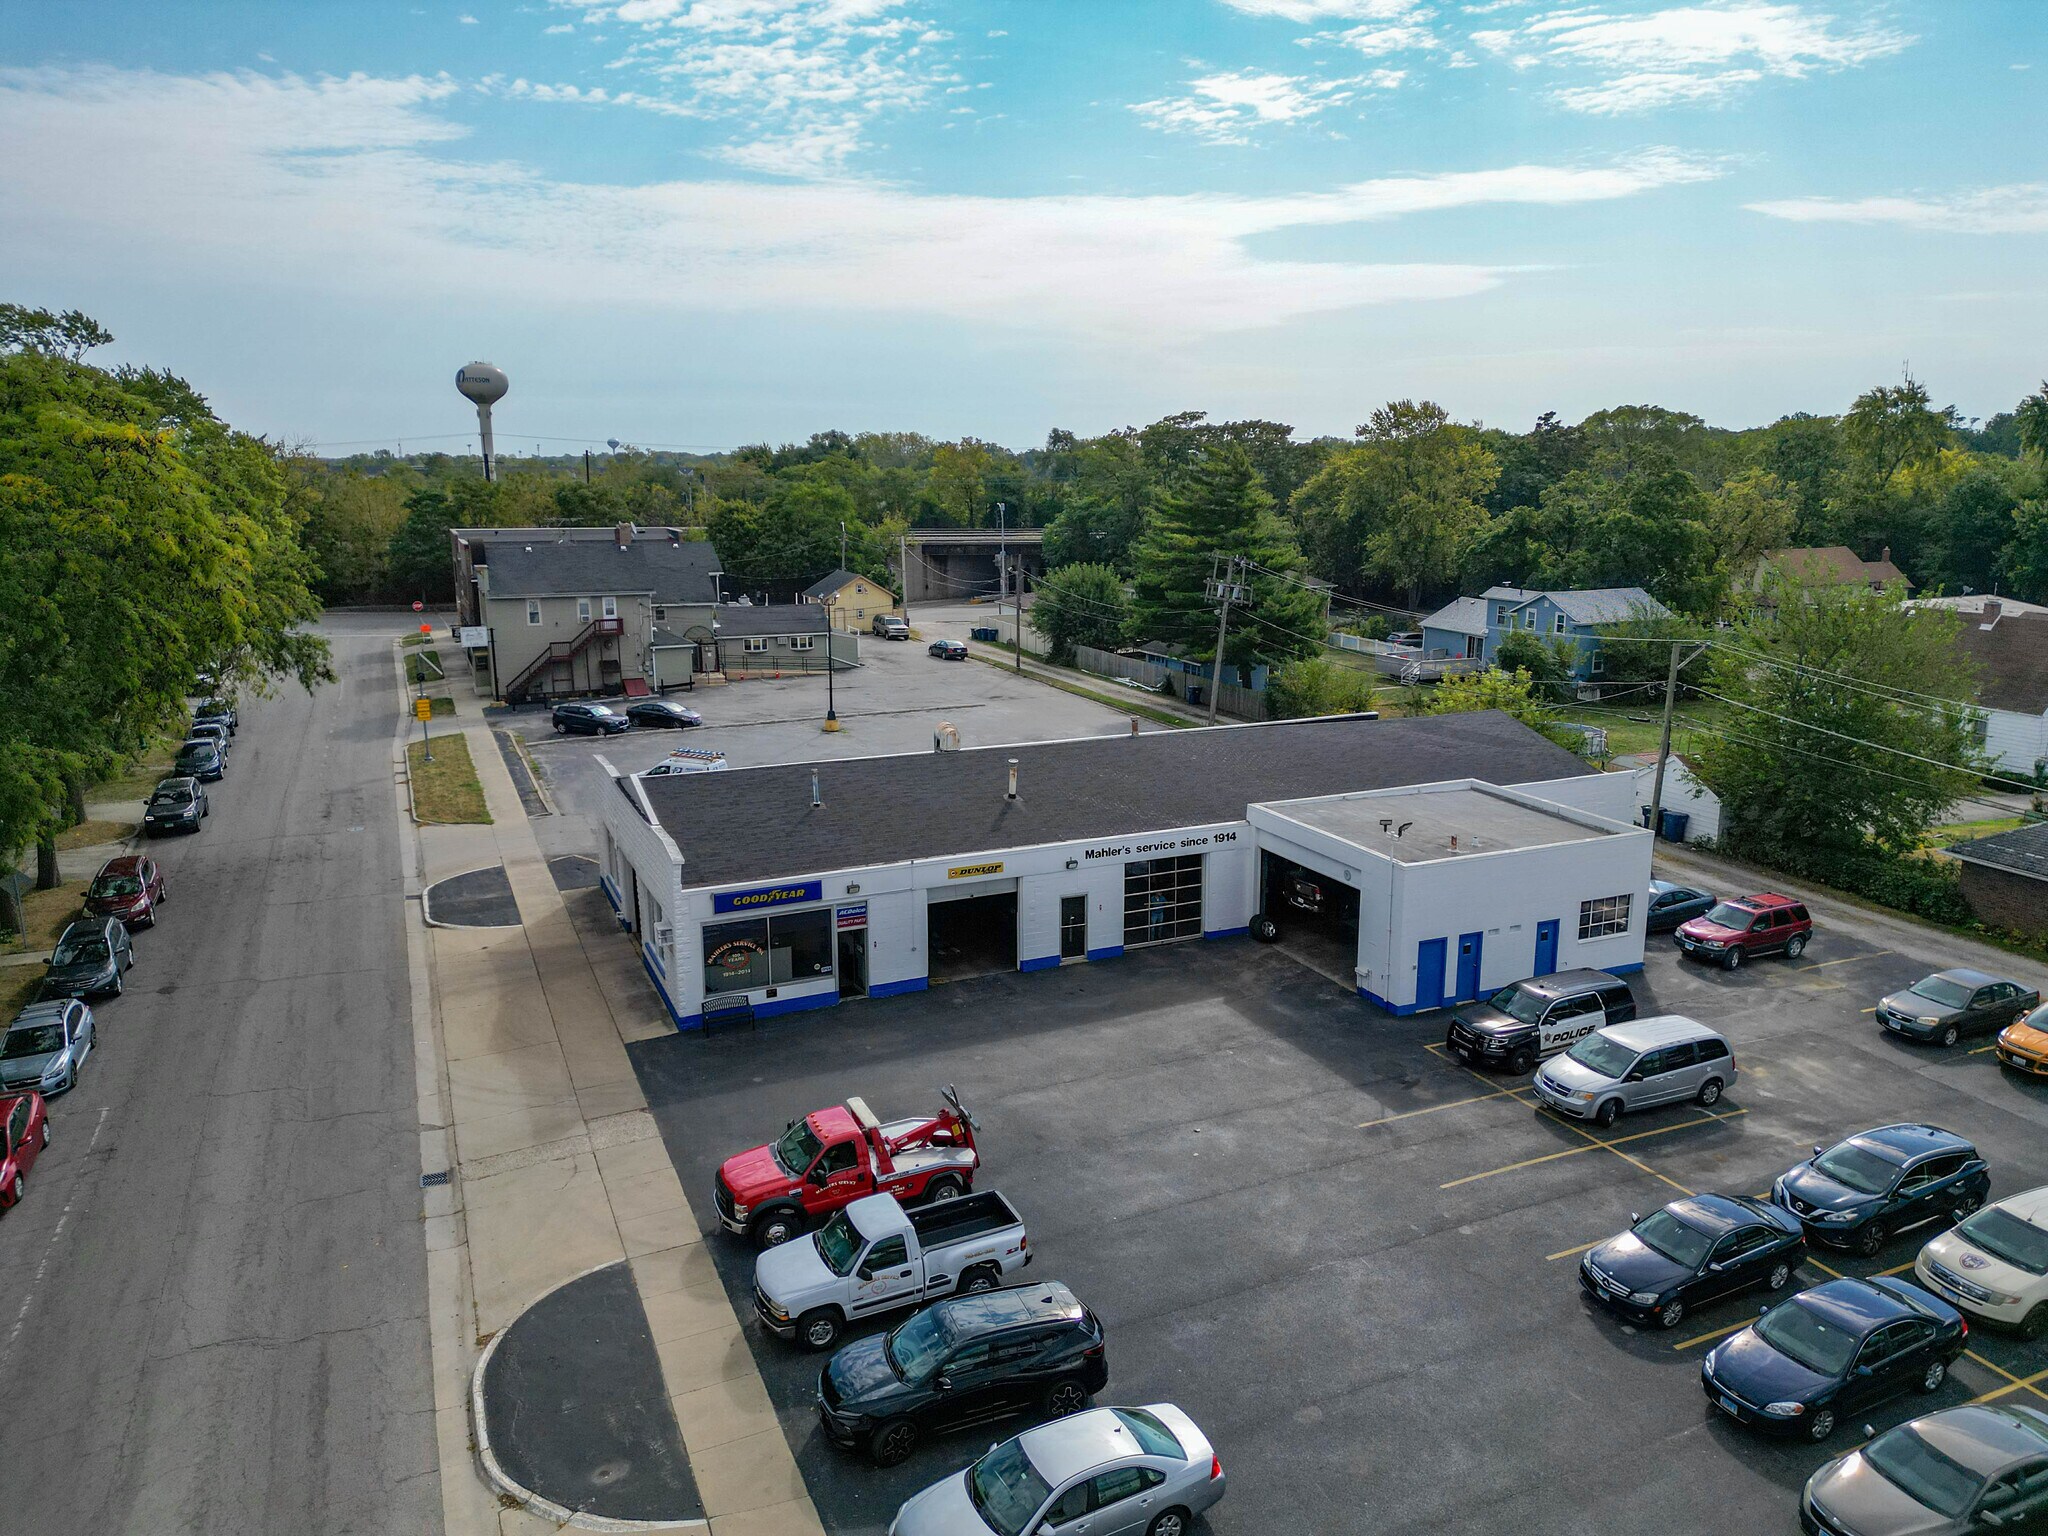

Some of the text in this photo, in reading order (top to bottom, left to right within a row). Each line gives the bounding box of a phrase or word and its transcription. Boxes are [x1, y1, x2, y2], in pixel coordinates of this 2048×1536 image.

[1085, 832, 1237, 860] Mahler's service since 1914
[959, 864, 1002, 875] DUNLOP
[733, 889, 806, 906] GOODYEAR
[1552, 1025, 1596, 1043] POLICE
